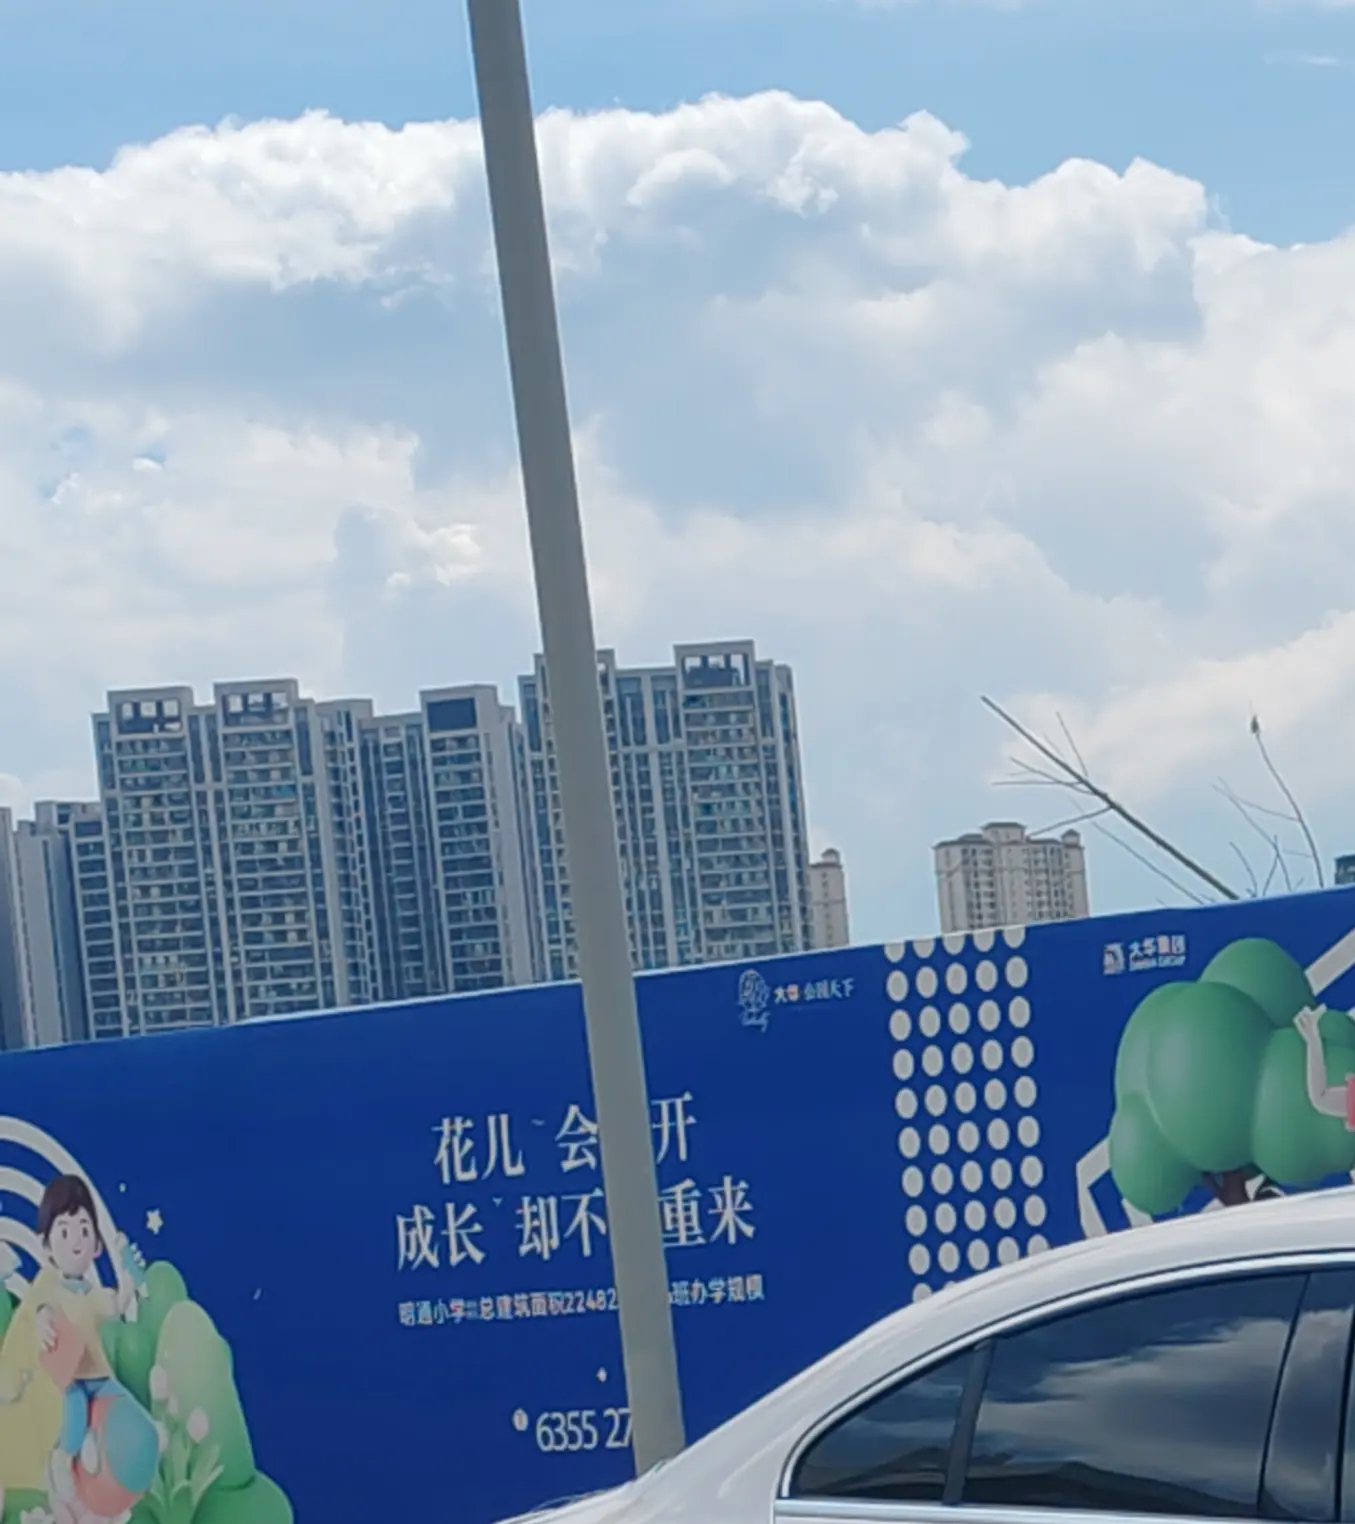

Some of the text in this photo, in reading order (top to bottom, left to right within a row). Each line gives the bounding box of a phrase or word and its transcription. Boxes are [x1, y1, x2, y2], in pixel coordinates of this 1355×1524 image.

[431, 1112, 525, 1185] 花儿
[396, 1201, 486, 1271] 成长
[536, 1410, 598, 1452] 6355
